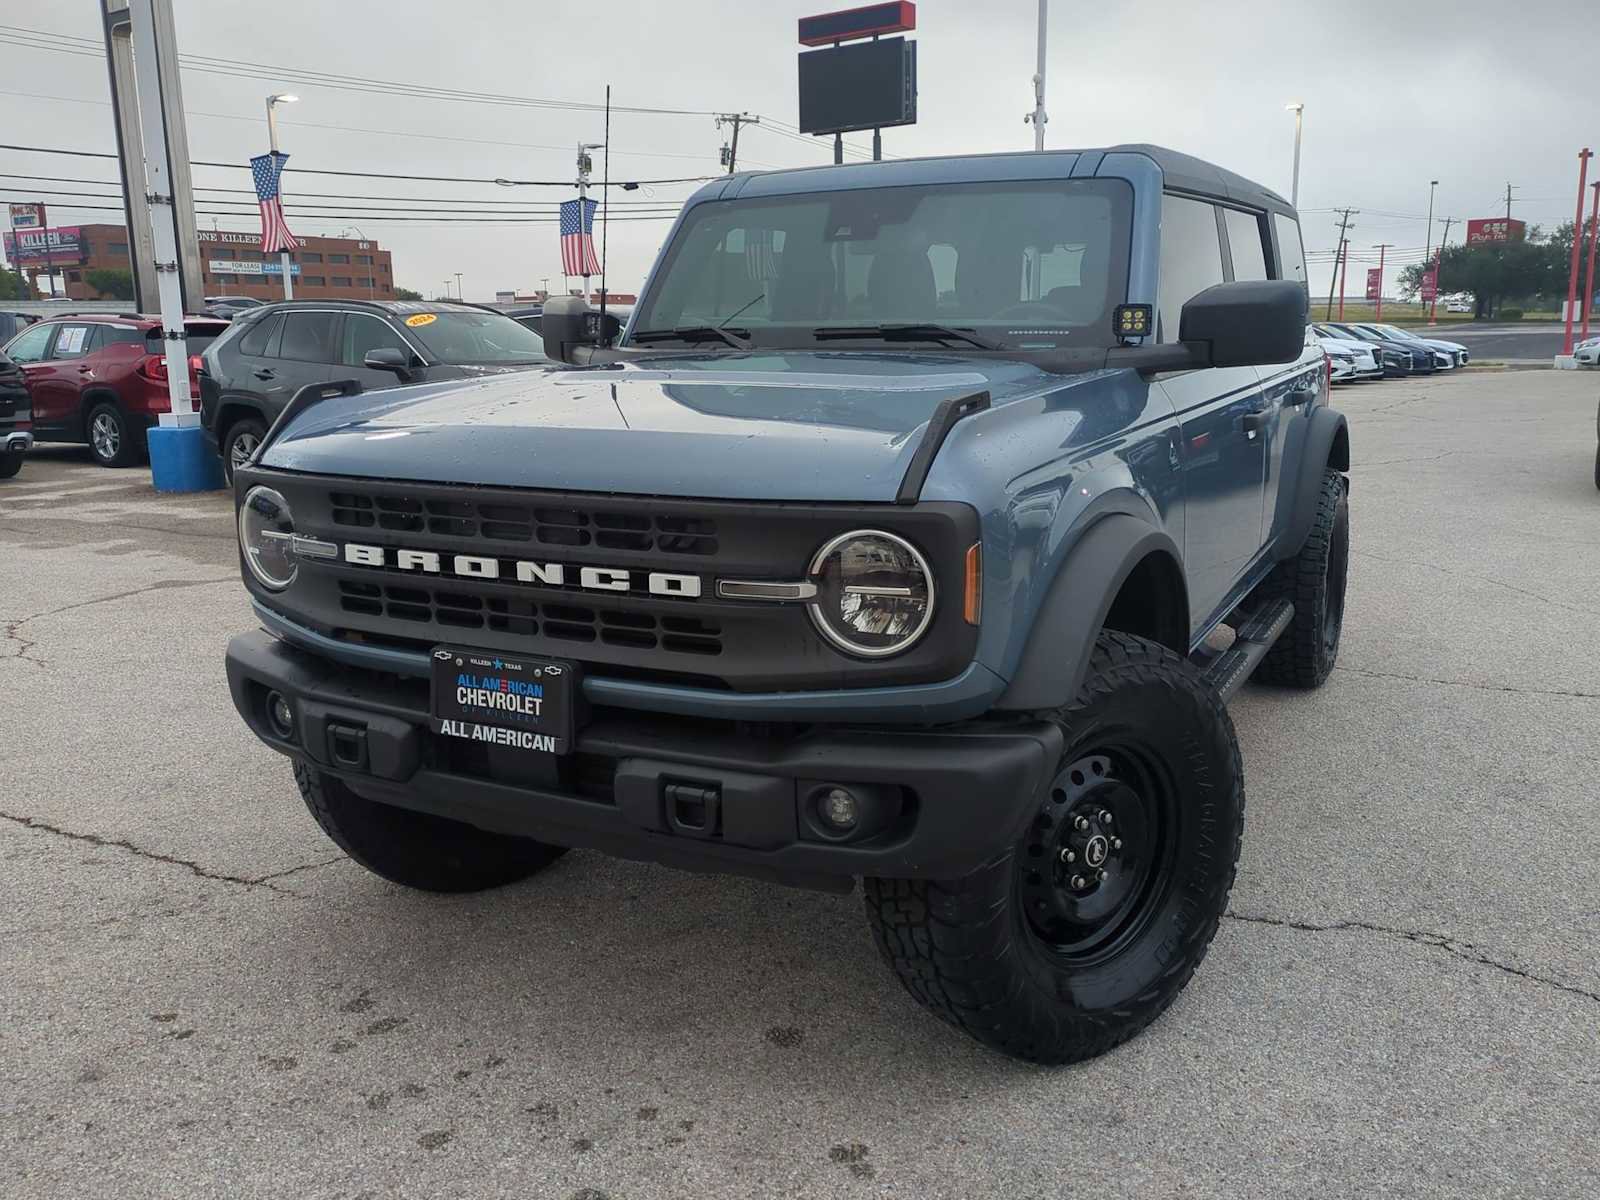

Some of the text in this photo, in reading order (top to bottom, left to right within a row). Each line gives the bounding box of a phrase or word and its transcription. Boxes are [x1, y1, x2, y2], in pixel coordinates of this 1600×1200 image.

[21, 232, 60, 247] KILLEEN
[344, 543, 701, 597] BRONCO
[470, 658, 522, 671] KILLEEN TEXAS
[457, 674, 543, 697] ALL AMERICAN
[456, 686, 543, 716] CHEVROLET
[440, 719, 556, 753] ALL AMERICAN
